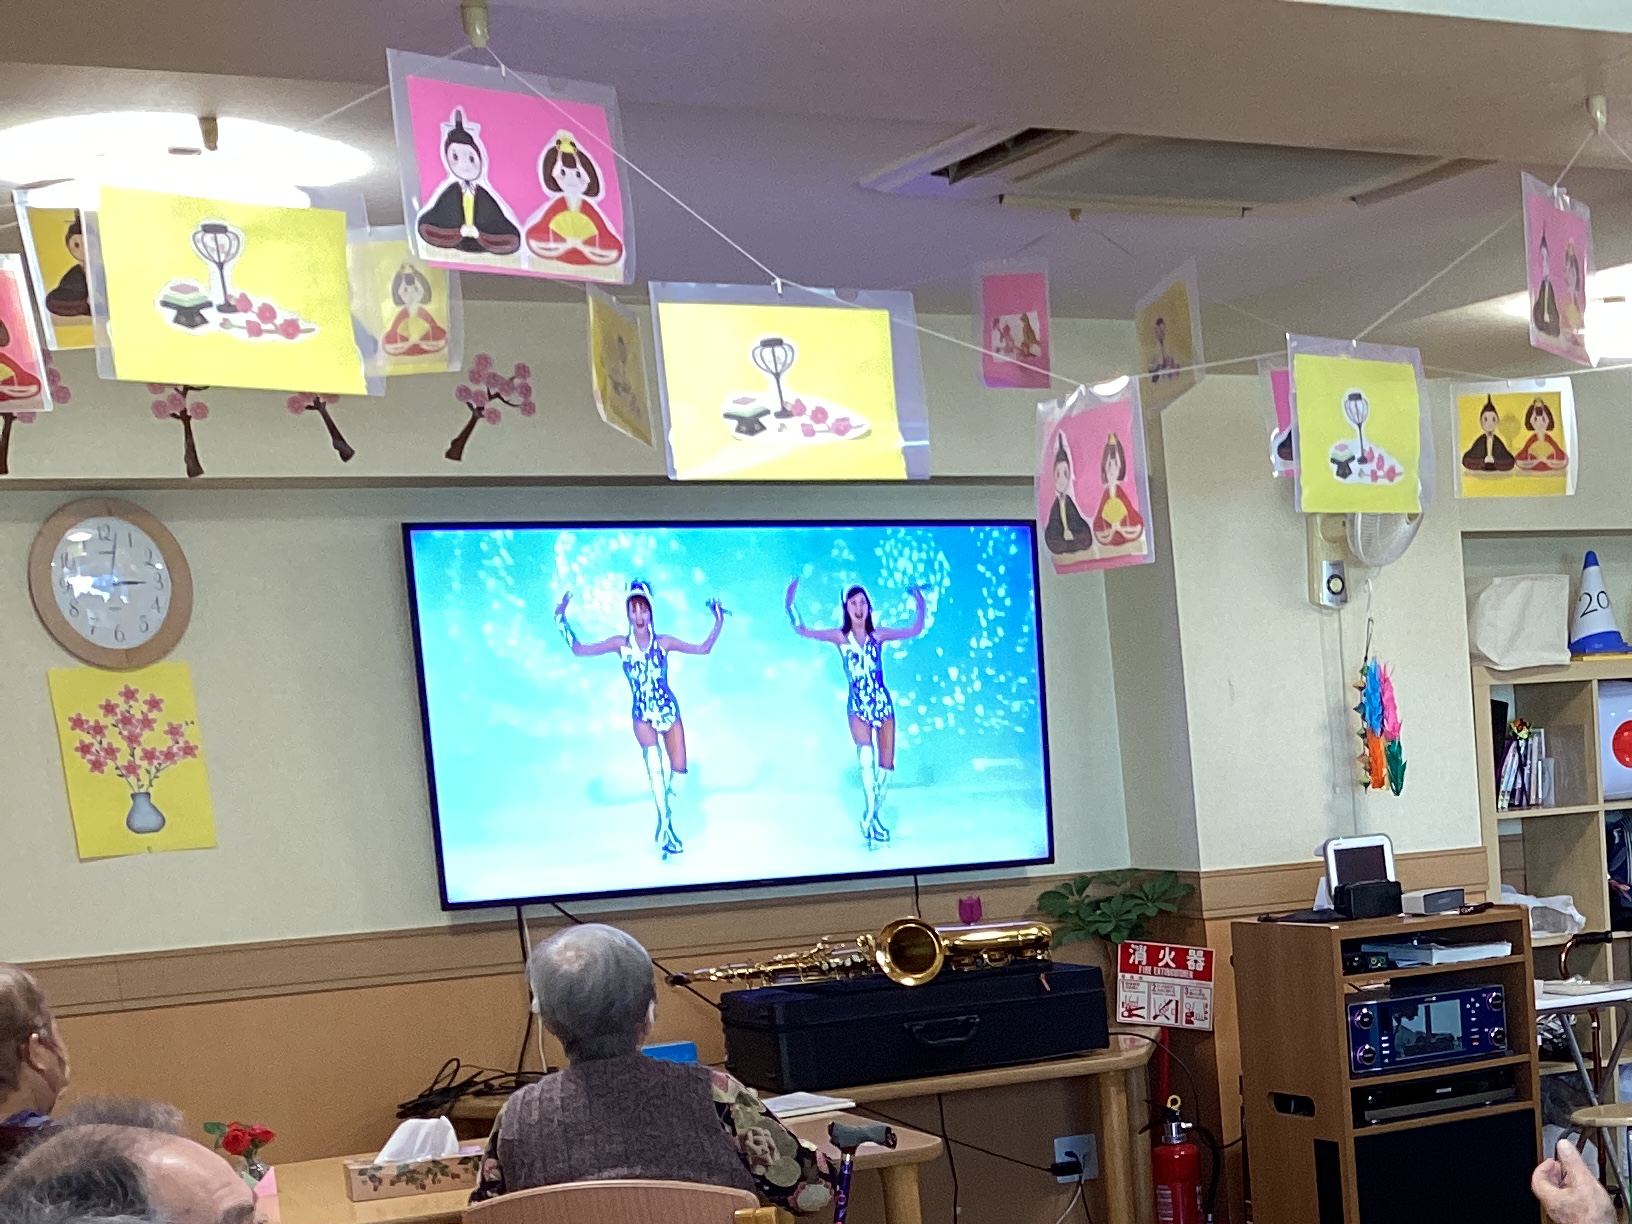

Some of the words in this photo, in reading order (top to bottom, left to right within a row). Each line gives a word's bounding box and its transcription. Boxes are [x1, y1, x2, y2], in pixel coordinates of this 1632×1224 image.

[97, 523, 112, 541] 12
[144, 548, 155, 568] 2
[153, 572, 165, 591] 3
[69, 600, 80, 618] 8
[151, 595, 161, 614] 4
[1579, 590, 1610, 619] 20
[113, 623, 126, 643] 6
[138, 614, 150, 633] 5
[1128, 943, 1206, 971] 消火器
